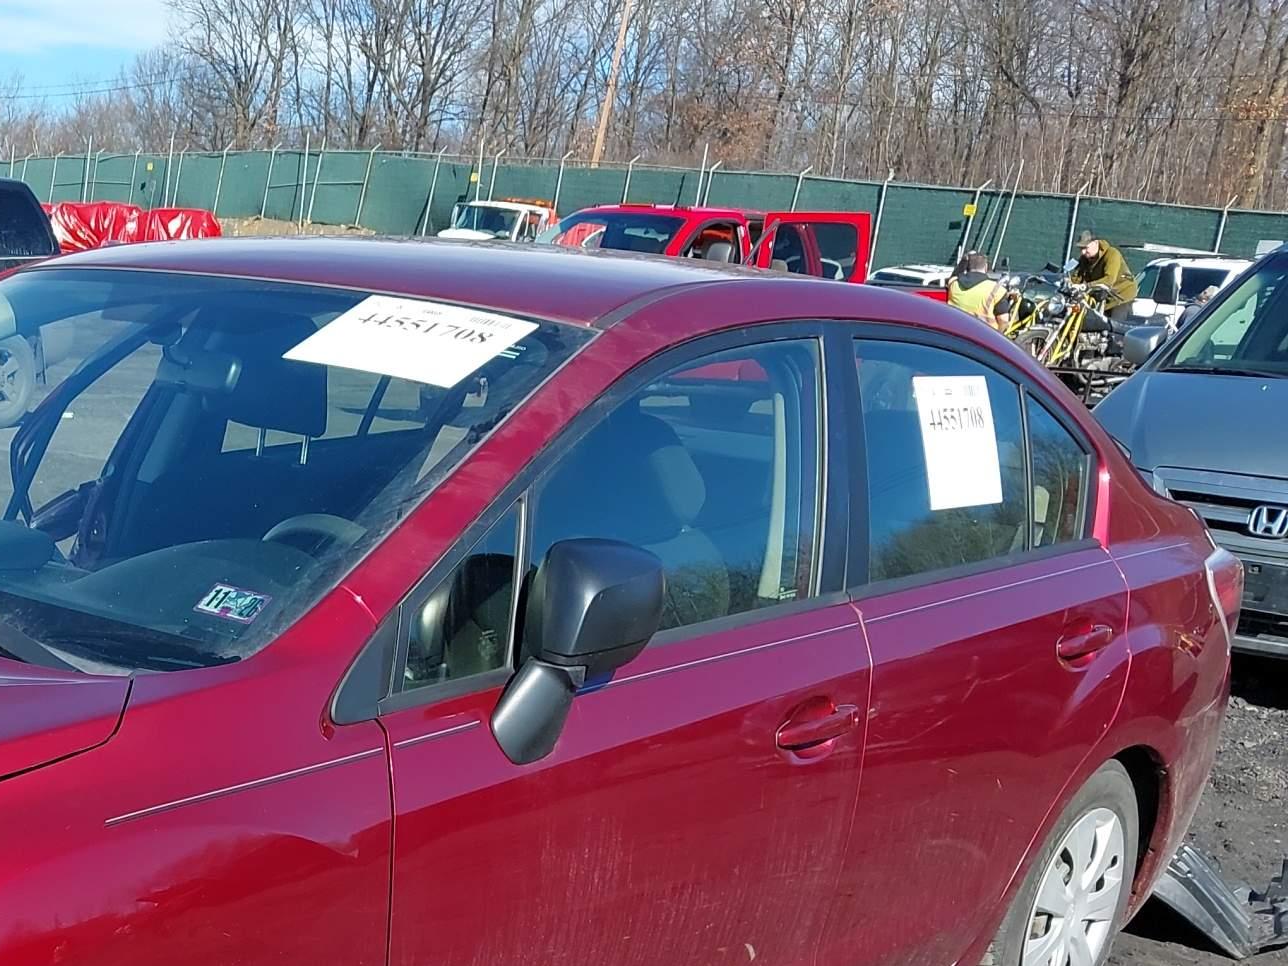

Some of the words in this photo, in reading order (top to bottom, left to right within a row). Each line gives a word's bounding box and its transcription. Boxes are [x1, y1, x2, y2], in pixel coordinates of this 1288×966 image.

[358, 312, 493, 343] 44551708
[929, 406, 985, 431] 44551708
[205, 588, 231, 608] 11
